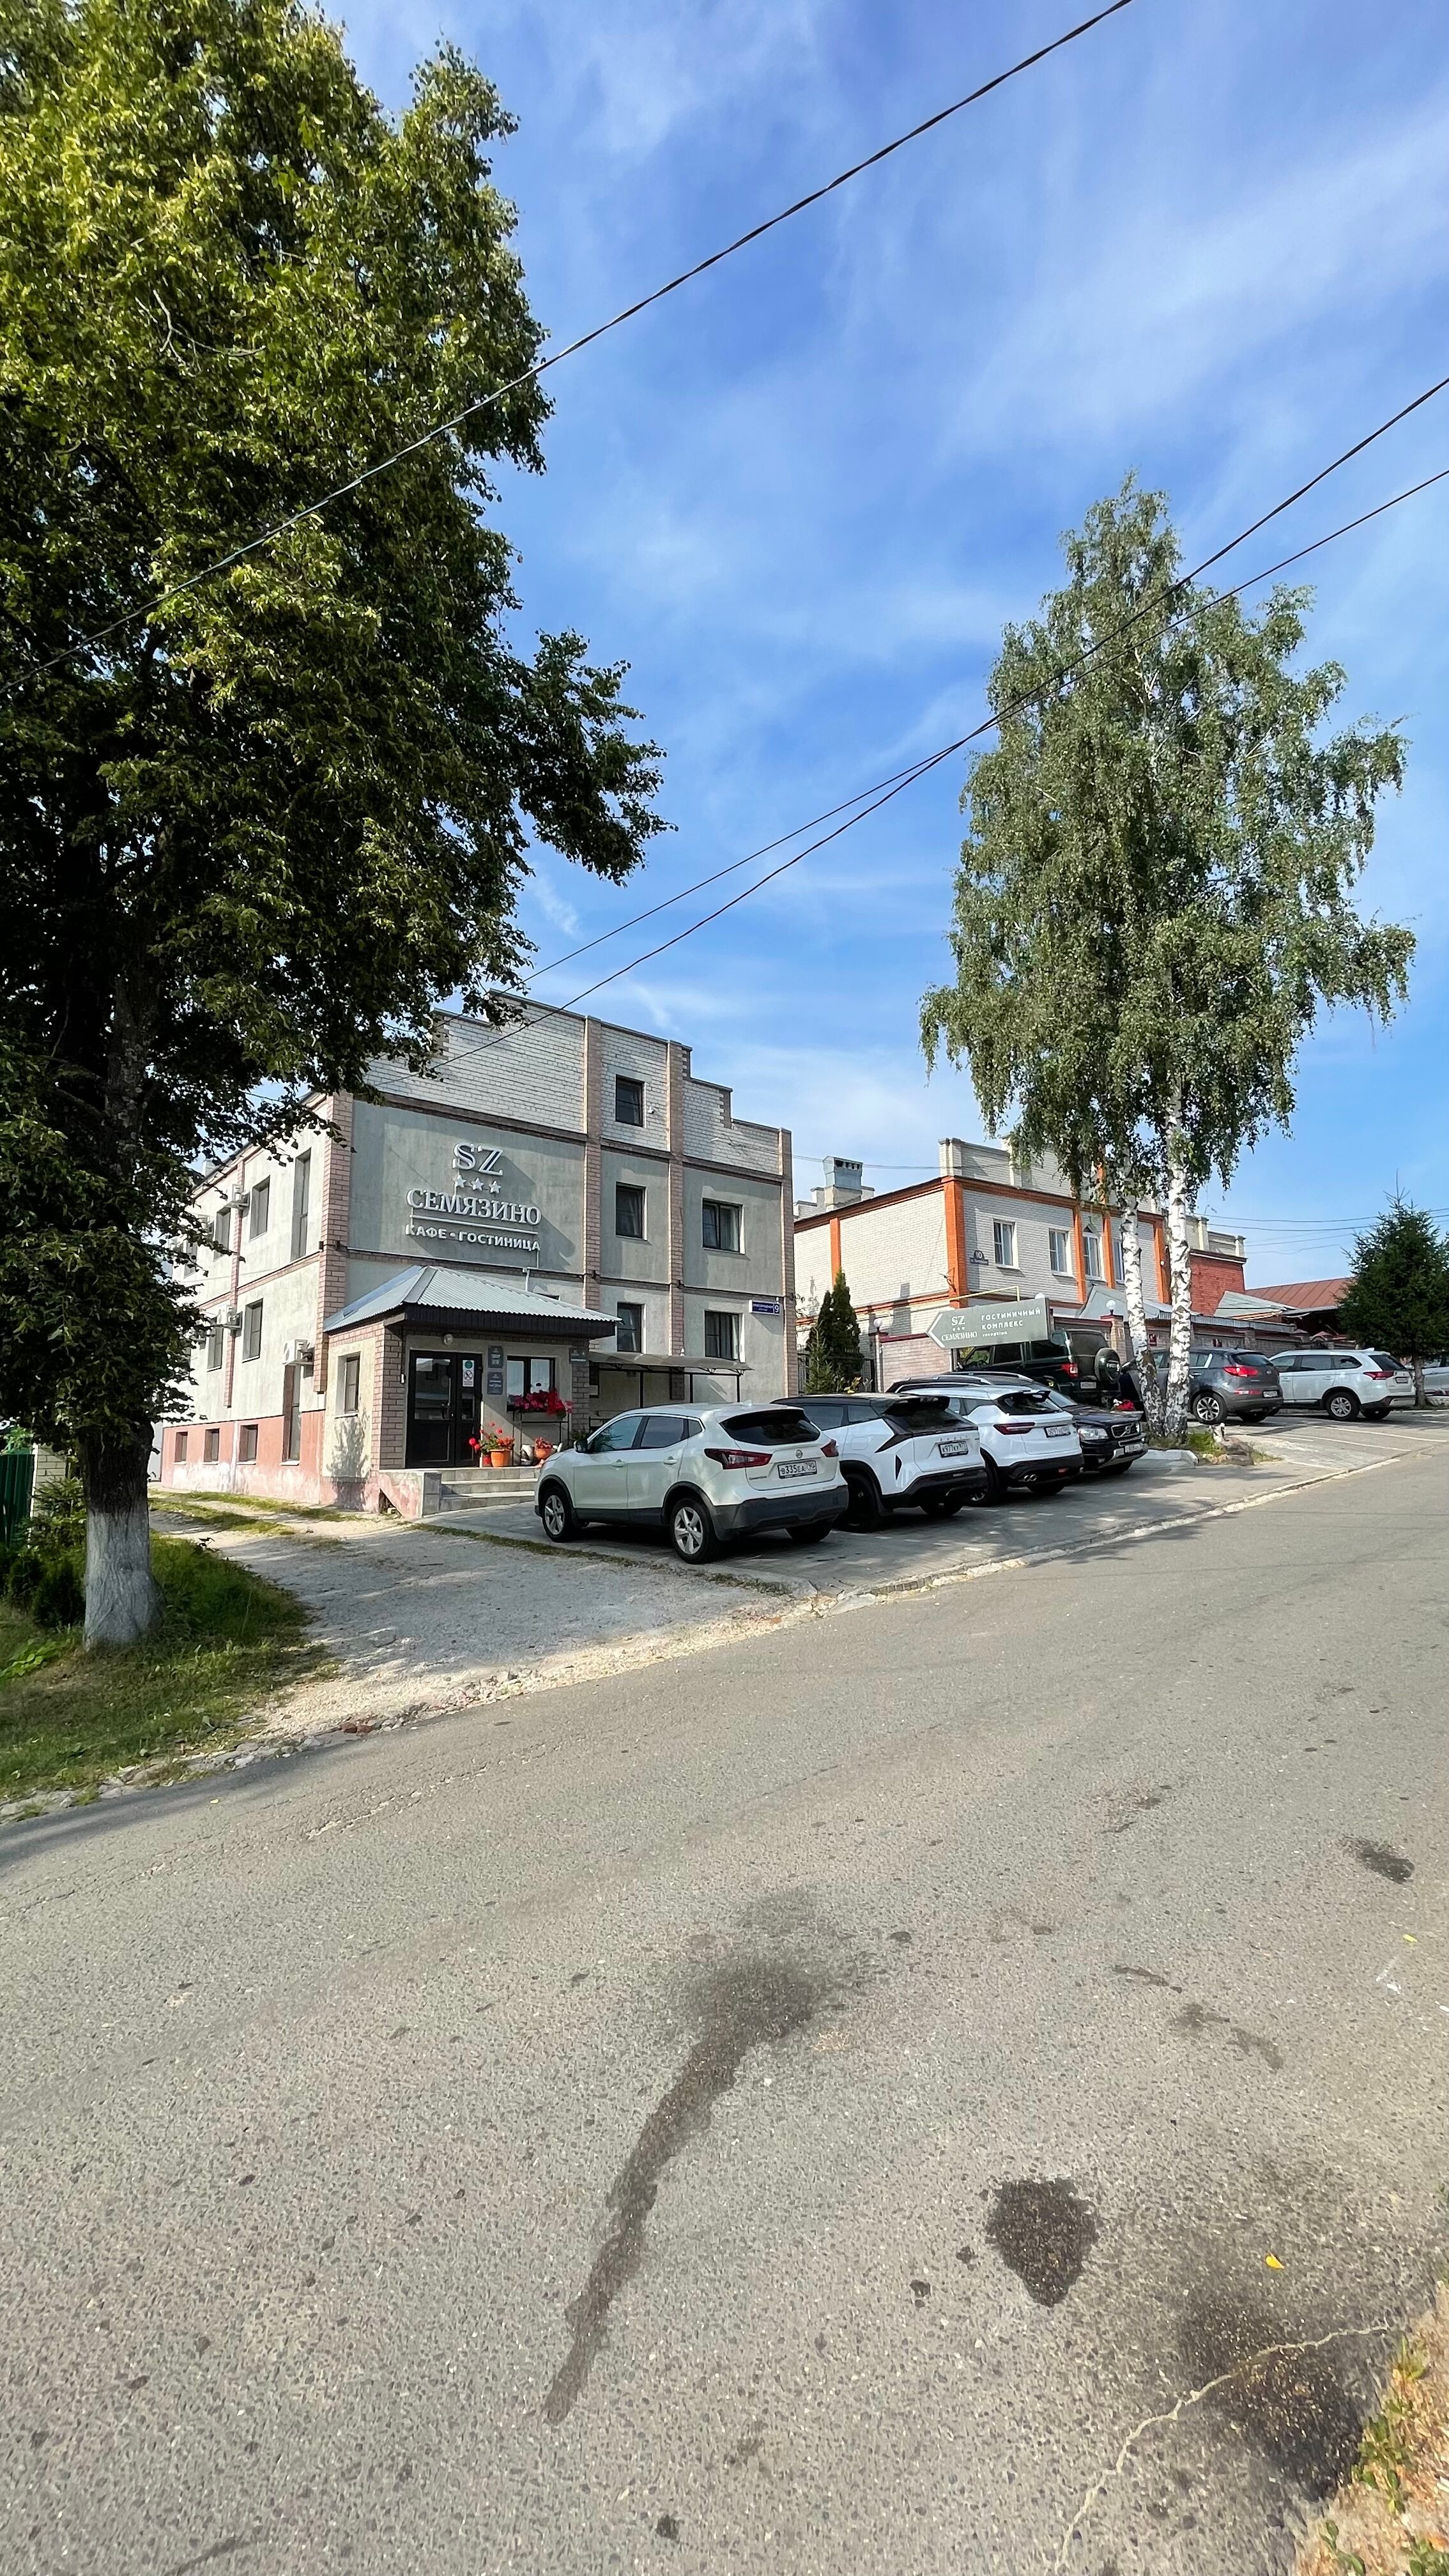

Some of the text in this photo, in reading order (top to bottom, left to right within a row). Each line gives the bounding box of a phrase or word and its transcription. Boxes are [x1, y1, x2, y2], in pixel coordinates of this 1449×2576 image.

[452, 1142, 503, 1176] SZ
[407, 1188, 542, 1225] СЕМЯЗИНО
[405, 1223, 540, 1252] КАФЕ ГОСТИНИЦА
[774, 1305, 779, 1313] 9
[981, 1307, 1041, 1322] ГОСТИНИЧНЫЙ
[951, 1315, 965, 1326] SZ
[981, 1320, 1023, 1331] КОМПЛЕКС
[941, 1331, 977, 1342] СЕМЯЗИНО
